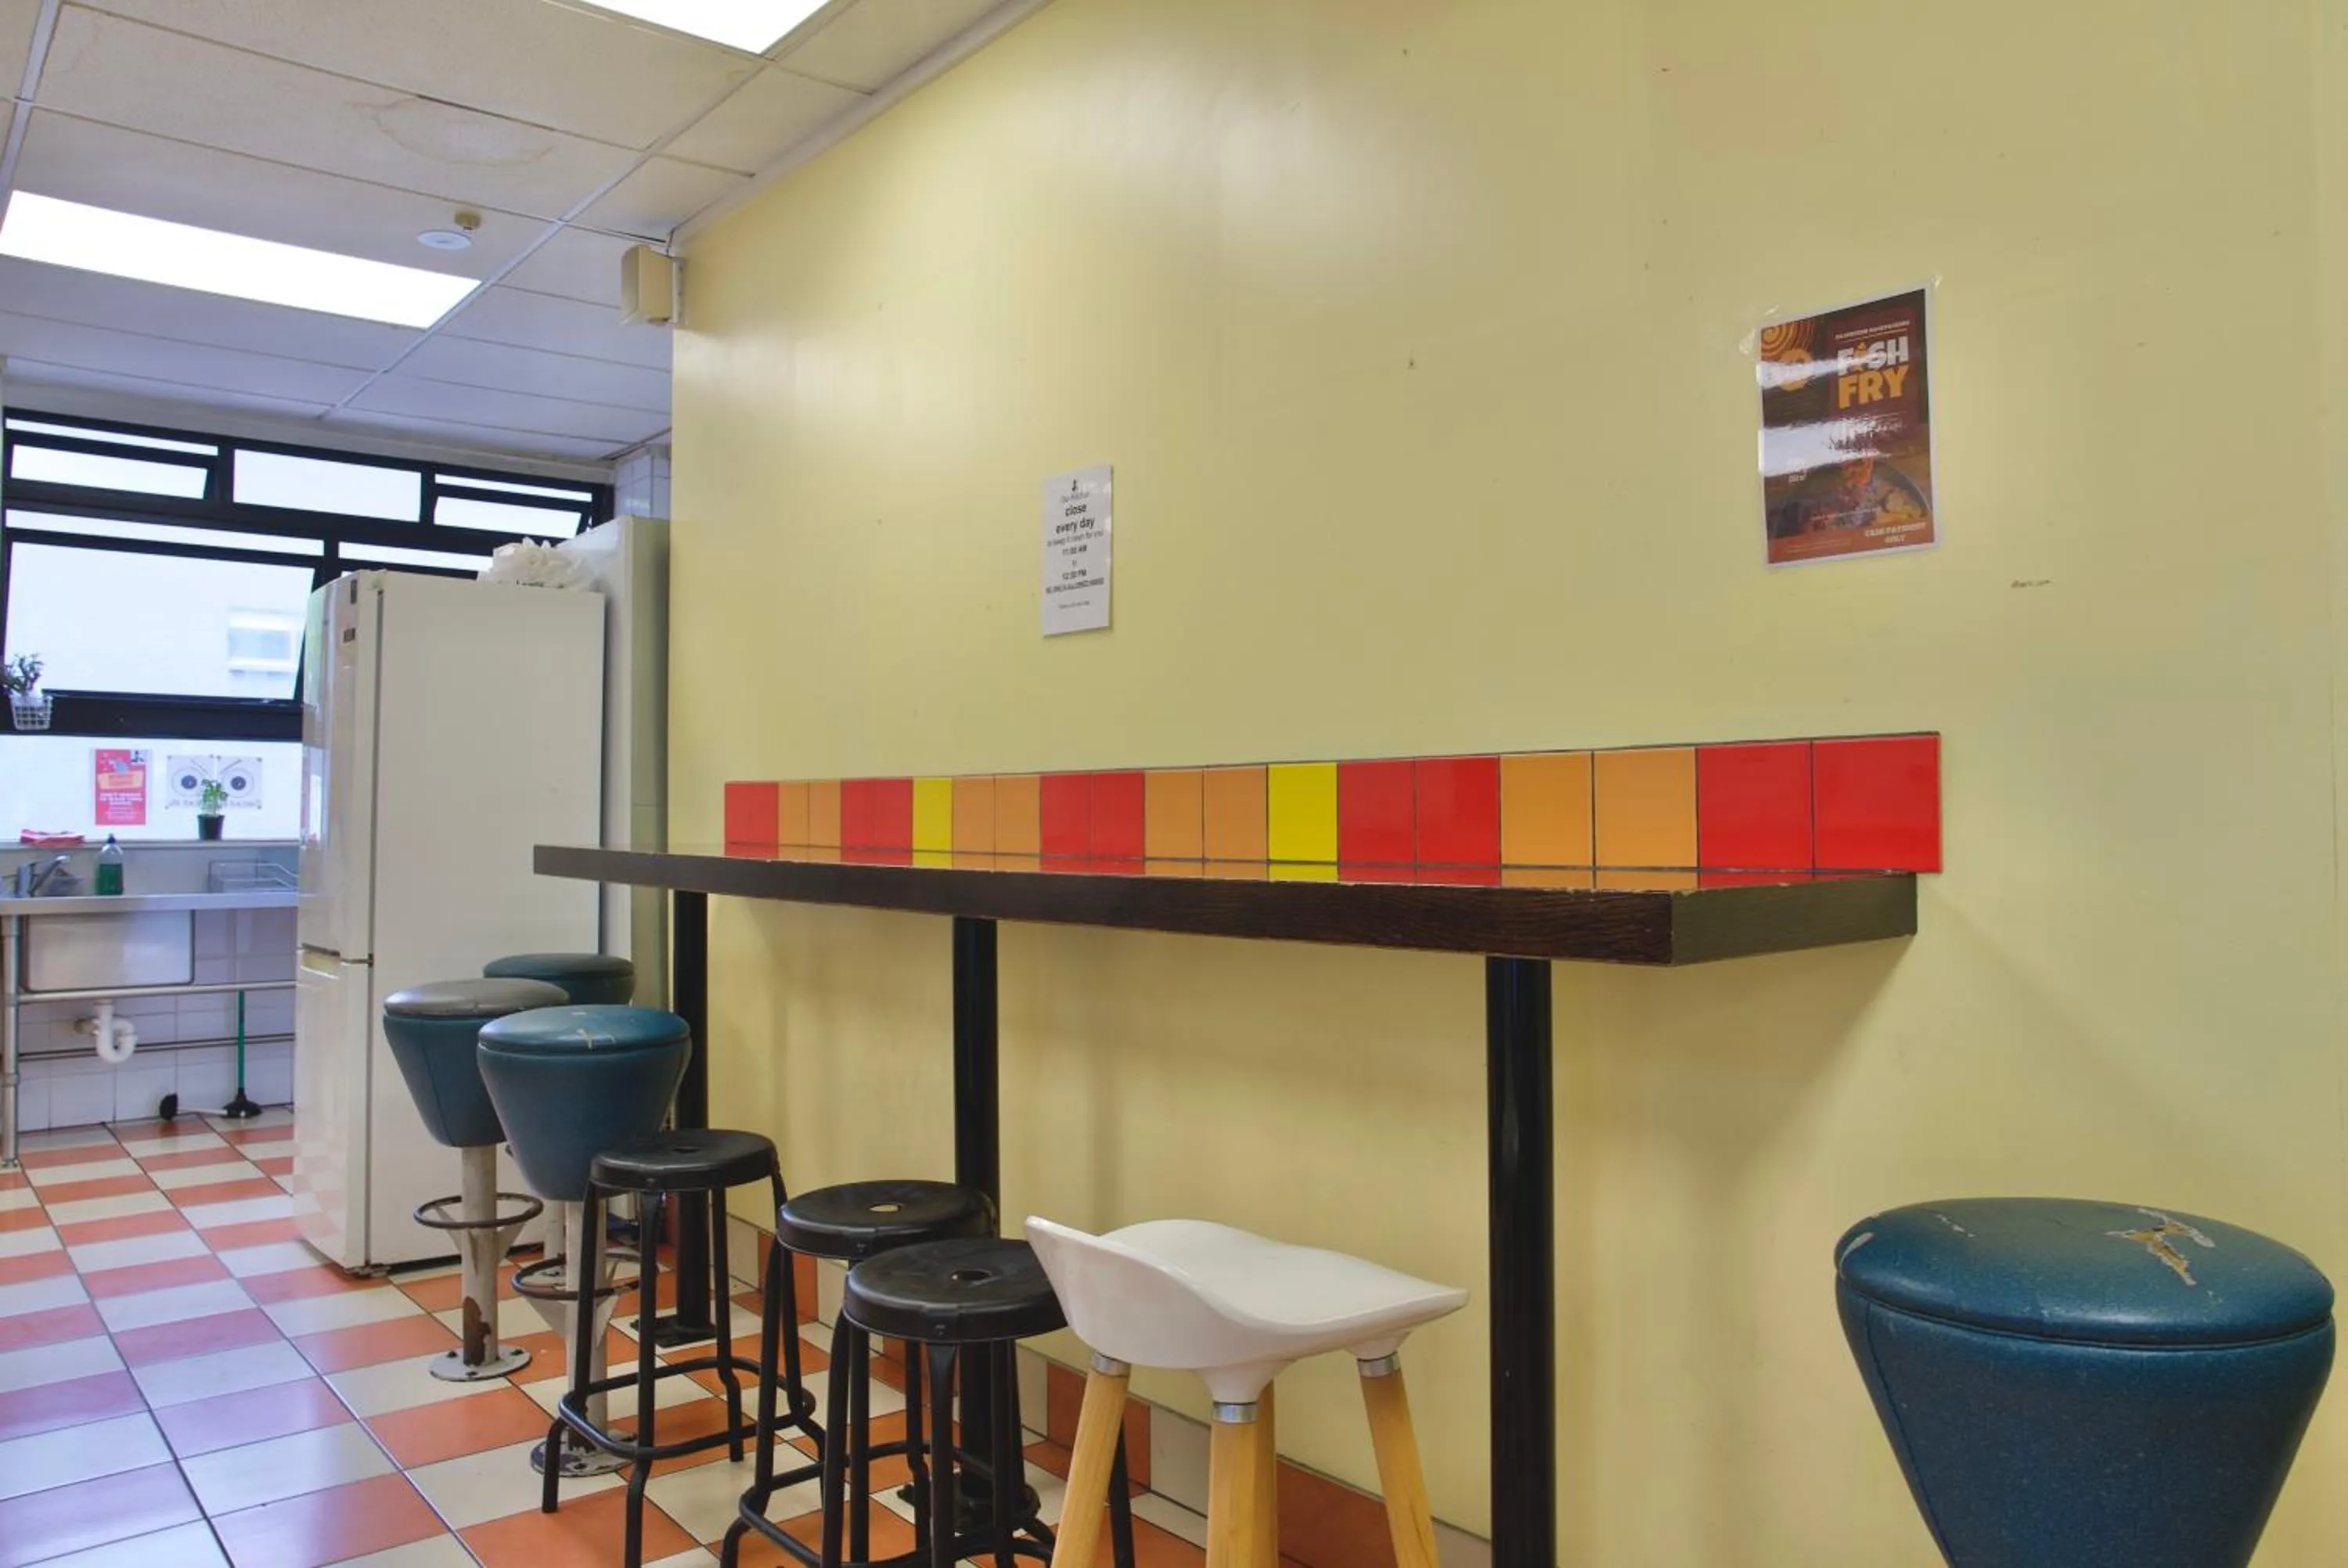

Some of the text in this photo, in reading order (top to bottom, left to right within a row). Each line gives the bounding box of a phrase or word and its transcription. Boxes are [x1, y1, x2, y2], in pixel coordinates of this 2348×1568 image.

[1837, 336, 1909, 376] FISH
[1838, 365, 1910, 409] FRY
[1065, 504, 1087, 516] close
[1056, 516, 1095, 534] every day
